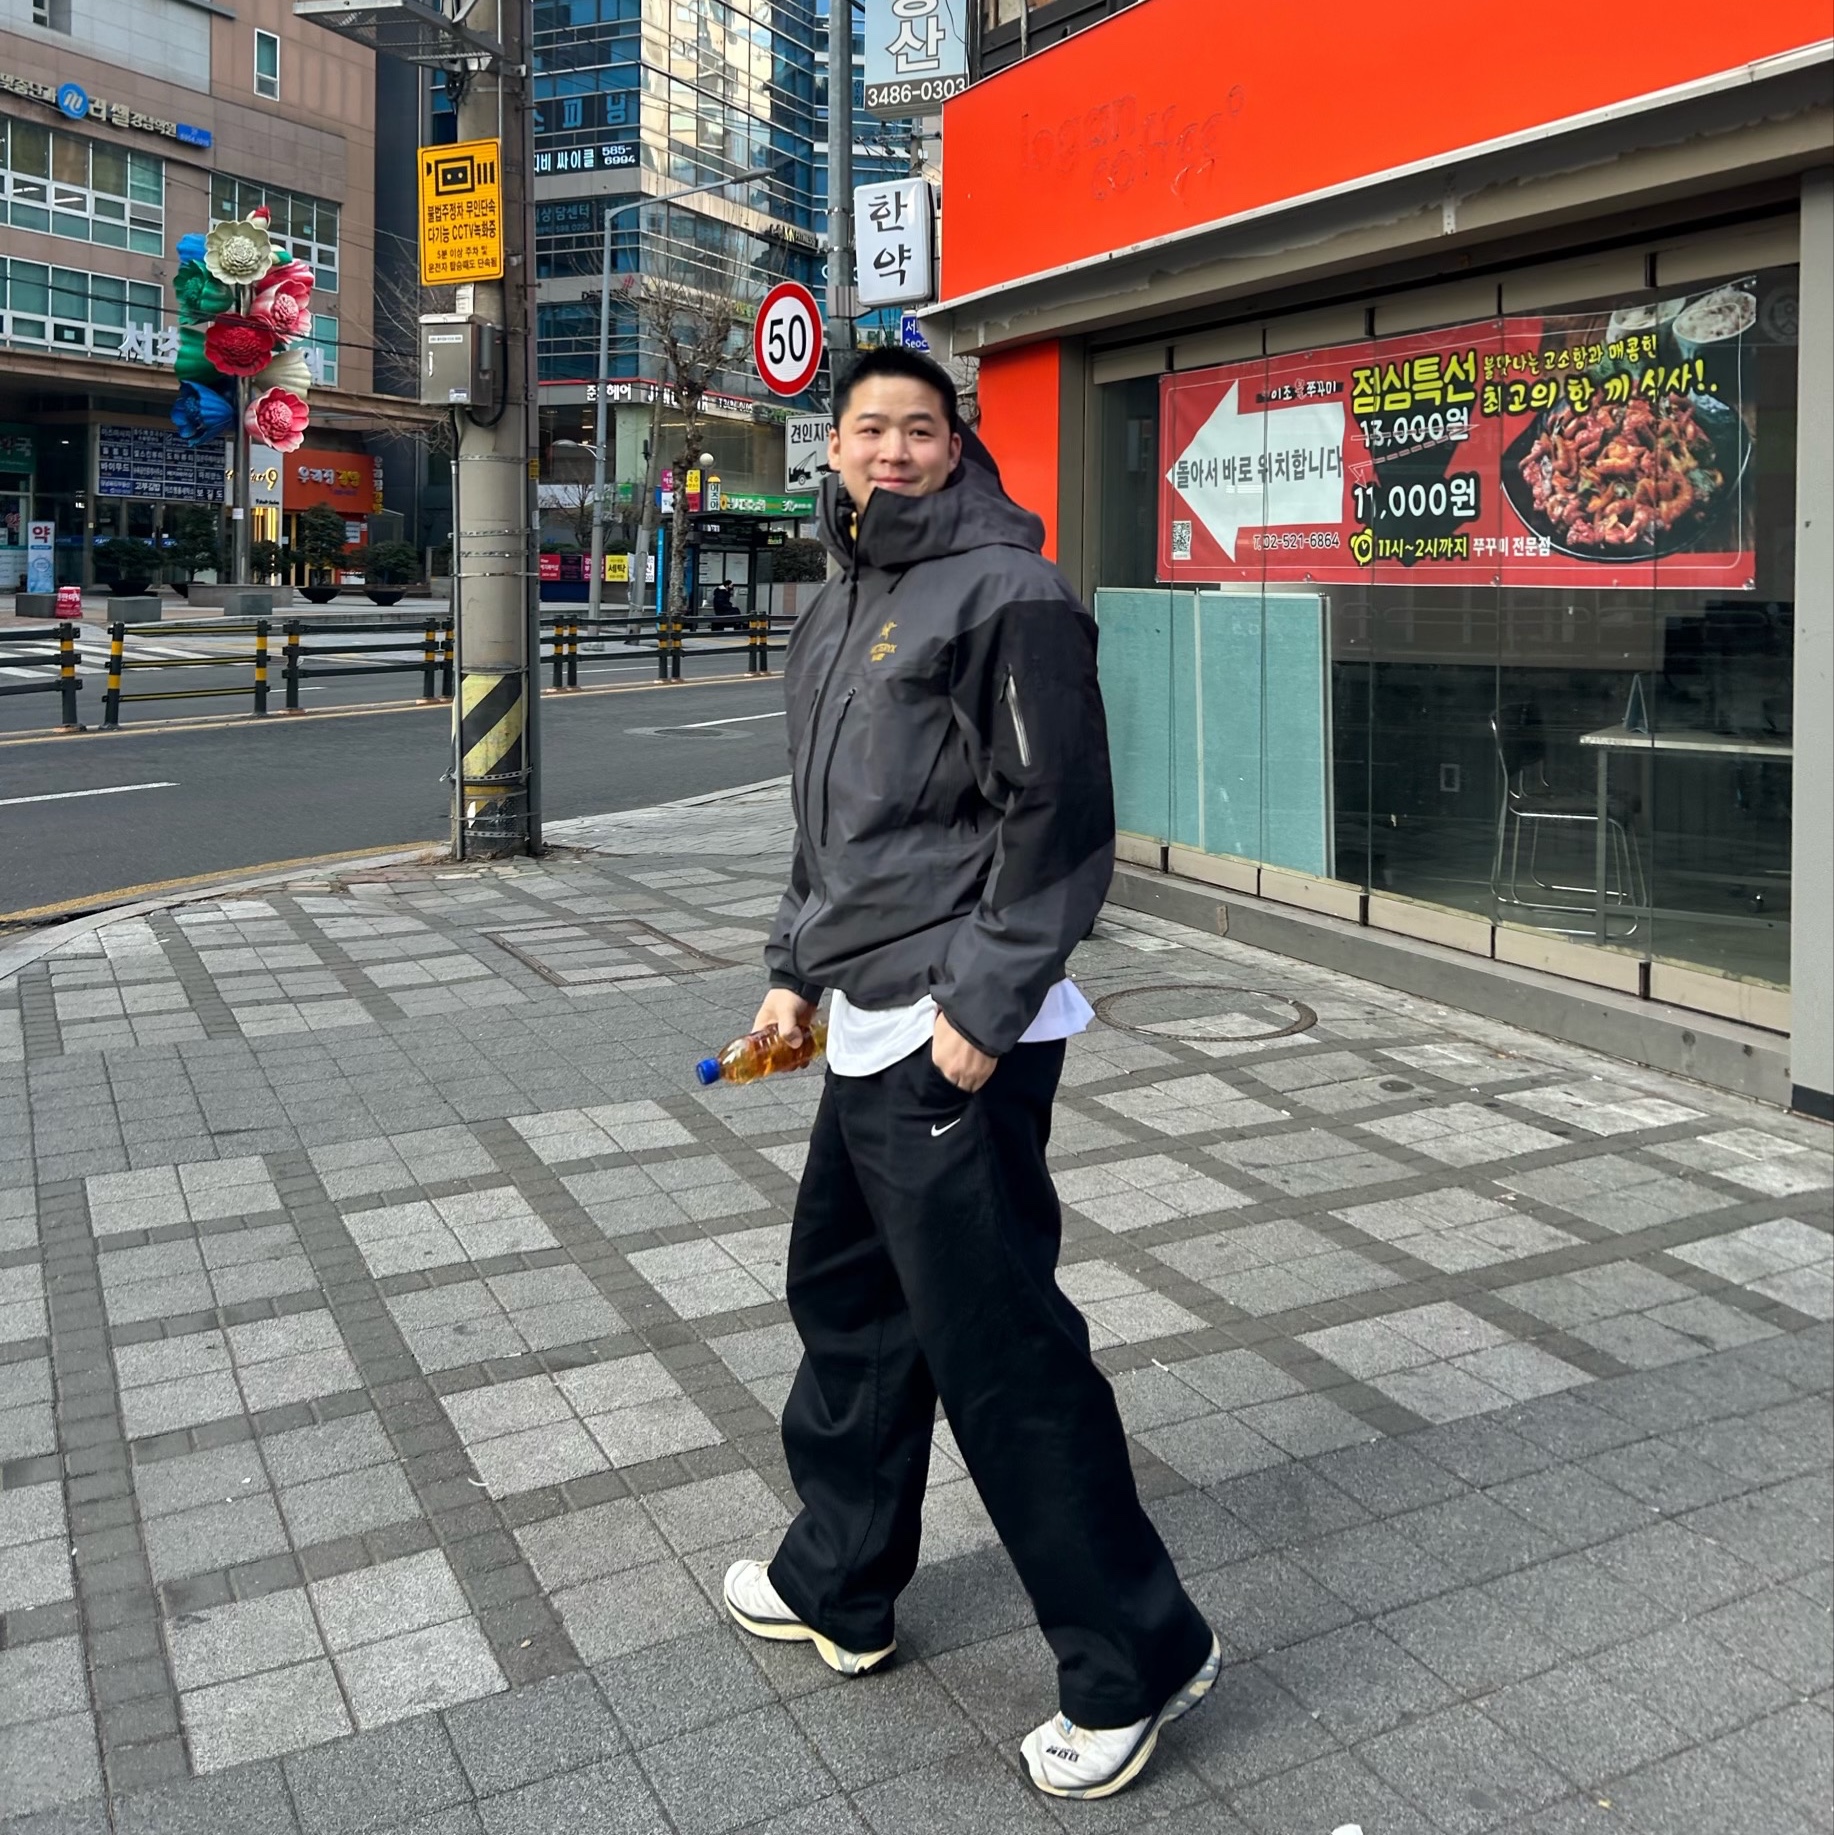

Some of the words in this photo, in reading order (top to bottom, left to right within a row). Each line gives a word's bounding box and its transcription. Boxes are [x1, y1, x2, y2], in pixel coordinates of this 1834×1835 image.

[867, 78, 966, 107] 3486-0303
[557, 148, 594, 170] 싸이클
[602, 145, 632, 156] 585-
[428, 201, 464, 223] 불법주정차
[466, 198, 496, 218] 무인단속
[536, 203, 590, 223] 상담센터
[428, 225, 450, 244] 다기능
[452, 220, 496, 241] CCTV녹화중
[868, 191, 912, 287] 한약
[437, 248, 448, 259] 5분
[450, 247, 463, 259] 이상
[465, 246, 479, 256] 주차
[428, 261, 448, 273] 운전자
[905, 319, 919, 336] 서
[768, 314, 807, 366] 50
[1483, 354, 1540, 380] 불맛나는
[586, 383, 631, 402] 준헤어
[1351, 350, 1477, 414] 점심특선
[1483, 380, 1557, 414] 최고의
[1568, 376, 1594, 413] 한
[1605, 374, 1630, 402] 끼
[1360, 406, 1469, 448] 13,000원
[1176, 457, 1218, 489] 돌아서
[1222, 455, 1253, 486] 바로
[1257, 445, 1343, 484] 위치합니다
[1354, 477, 1475, 519] 11,000원
[33, 526, 51, 544] 약
[1512, 536, 1551, 557] 전문점
[1378, 537, 1468, 559] 11시~2시까지
